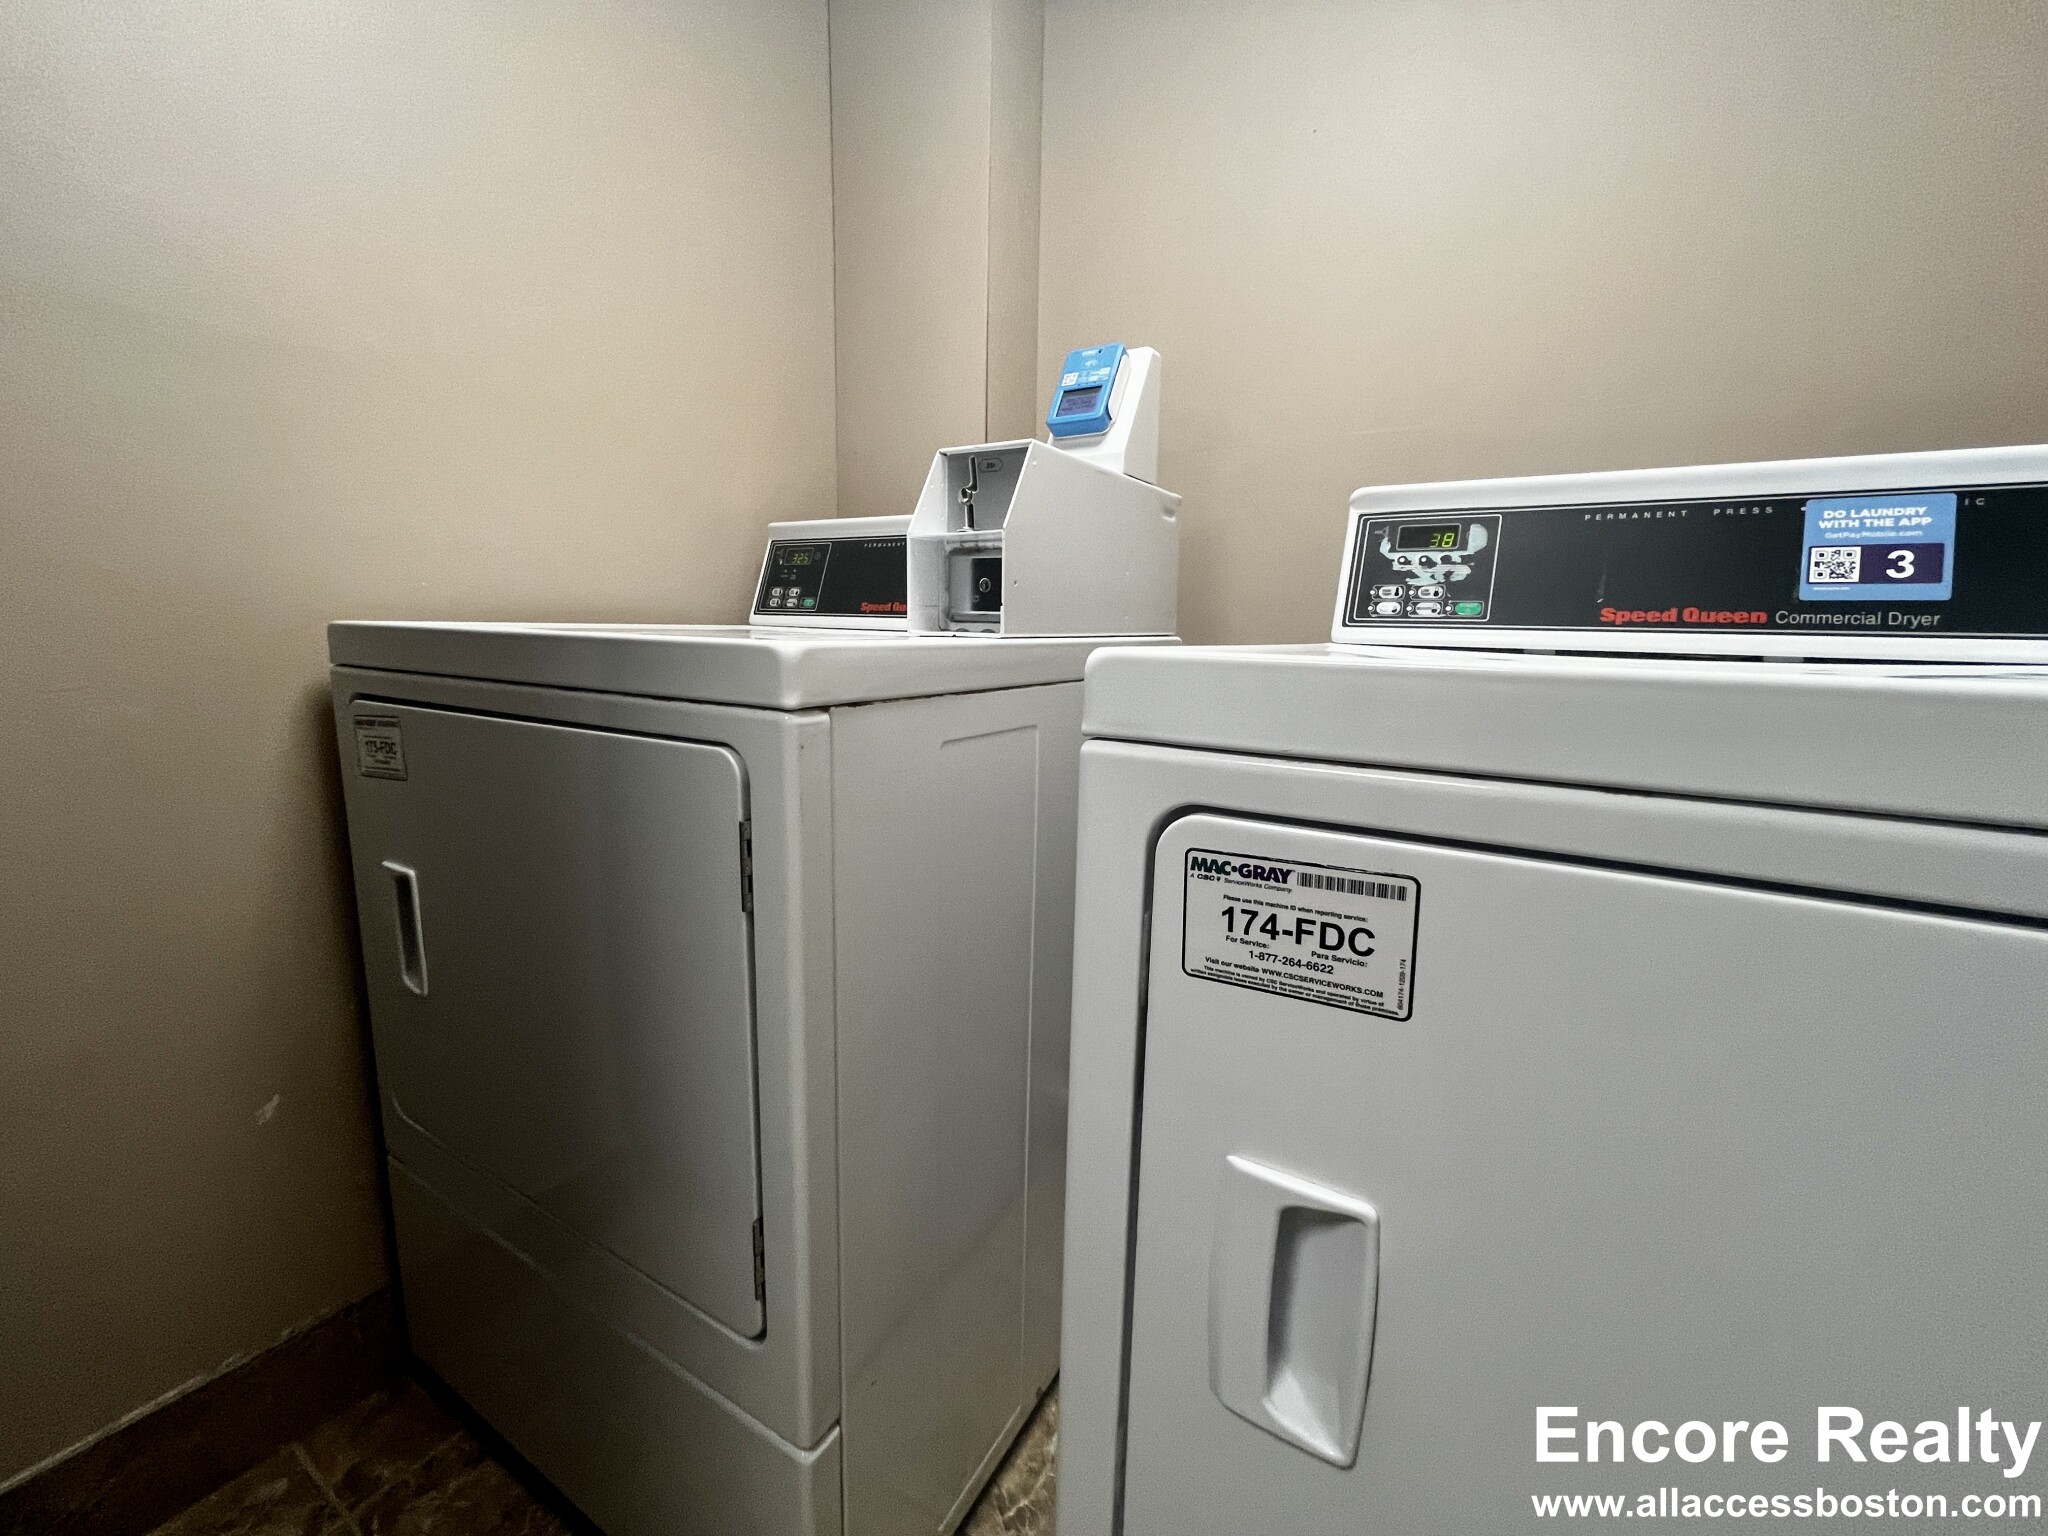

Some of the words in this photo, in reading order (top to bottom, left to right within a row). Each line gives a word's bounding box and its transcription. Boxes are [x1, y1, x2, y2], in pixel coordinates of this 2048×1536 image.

[1584, 509, 1688, 521] PERMANENT
[1713, 506, 1774, 516] PRESS
[1823, 510, 1847, 519] DO
[1850, 506, 1928, 519] LAUNDRY
[1818, 519, 1860, 529] WITH
[1863, 518, 1895, 527] THE
[1898, 517, 1934, 527] APP
[1430, 533, 1455, 548] 38
[1824, 530, 1924, 539] GetPayMobile.com
[1885, 549, 1915, 579] 3
[861, 602, 892, 612] Speed
[1600, 607, 1678, 625] Speed
[1682, 607, 1768, 624] Queen
[1775, 610, 1881, 625] Commercial
[1888, 612, 1941, 629] Dryer
[1197, 873, 1215, 882] CSC
[1224, 878, 1262, 889] ServiceWorks
[1264, 884, 1292, 894] Company
[1223, 894, 1241, 902] Please
[1265, 901, 1289, 910] machine
[1315, 909, 1342, 920] reporting
[1344, 914, 1368, 922] service:
[1221, 906, 1376, 957] 174-FDC
[1225, 935, 1238, 943] For
[1240, 938, 1269, 949] Service:
[1249, 950, 1334, 975] 1-877-264-6622
[1311, 951, 1329, 960] Para
[1331, 954, 1368, 967] Servicio:
[1205, 956, 1220, 965] Visit
[1234, 963, 1260, 973] website
[1261, 967, 1384, 998] WWW.CSCSERVICEWORKS.COM
